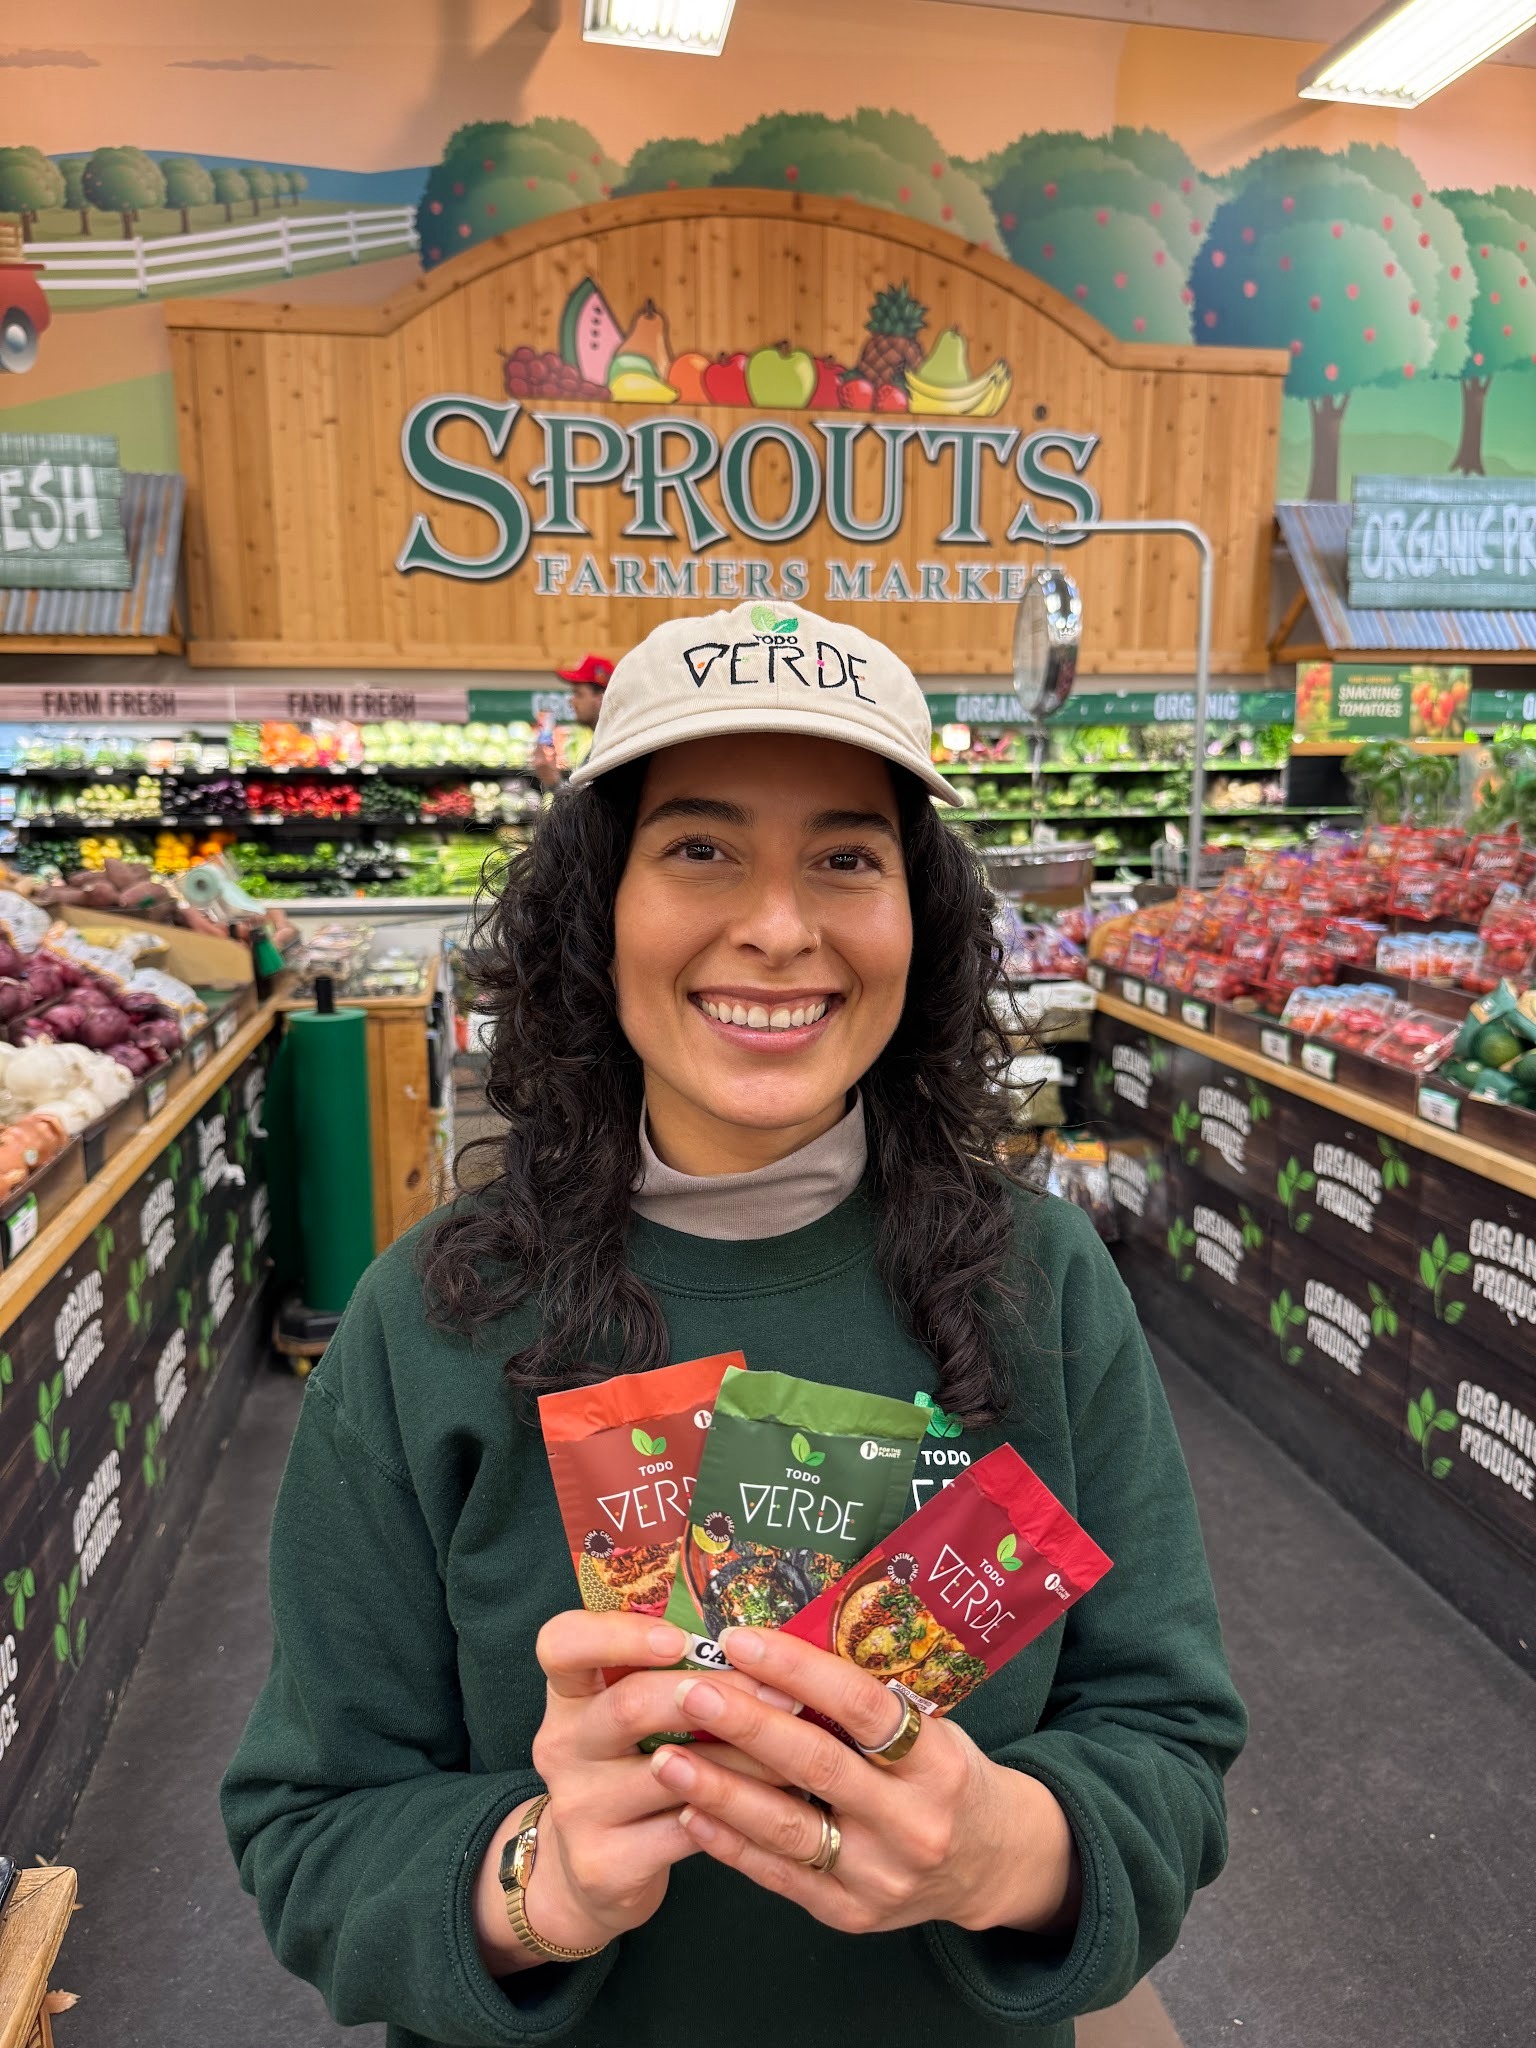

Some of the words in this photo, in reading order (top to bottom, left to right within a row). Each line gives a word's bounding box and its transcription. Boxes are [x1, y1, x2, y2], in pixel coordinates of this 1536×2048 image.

[395, 393, 1100, 579] SPROUTS
[0, 458, 103, 552] ESH
[1361, 506, 1497, 581] ORGANIC
[534, 554, 810, 600] FARMERS
[753, 634, 798, 645] TODO
[683, 641, 876, 704] VERDE
[42, 689, 102, 717] FARM
[108, 690, 177, 717] FRESH
[287, 691, 345, 718] FARM
[351, 692, 417, 718] FRESH
[955, 694, 1034, 723] ORGAN
[1154, 693, 1240, 721] ORGNIC
[1338, 701, 1402, 718] TOMATOES
[1313, 1141, 1383, 1204] ORGANIC
[1315, 1179, 1376, 1234] PRODUCE
[1304, 1279, 1371, 1350] ORGANIC
[1307, 1315, 1363, 1376] PRODUCE
[638, 1460, 674, 1477] TODO
[921, 1450, 971, 1467] TODO
[1460, 1423, 1536, 1501] PRODUCE
[785, 1467, 821, 1485] TODO
[73, 1449, 121, 1555] ORGANIC
[597, 1476, 697, 1532] VER
[739, 1482, 864, 1541] VERDE
[703, 1511, 723, 1527] LATINA
[724, 1515, 735, 1534] CHEF
[584, 1530, 599, 1550] LATINA
[600, 1530, 615, 1546] CHEF
[705, 1529, 730, 1542] OWNED
[590, 1547, 614, 1559] OWNED
[891, 1552, 915, 1563] LATINA
[887, 1565, 906, 1585] OWNED
[909, 1563, 919, 1582] CHEF
[979, 1558, 1006, 1588] TODO
[928, 1543, 1016, 1644] VERDE
[0, 1634, 18, 1698] IC
